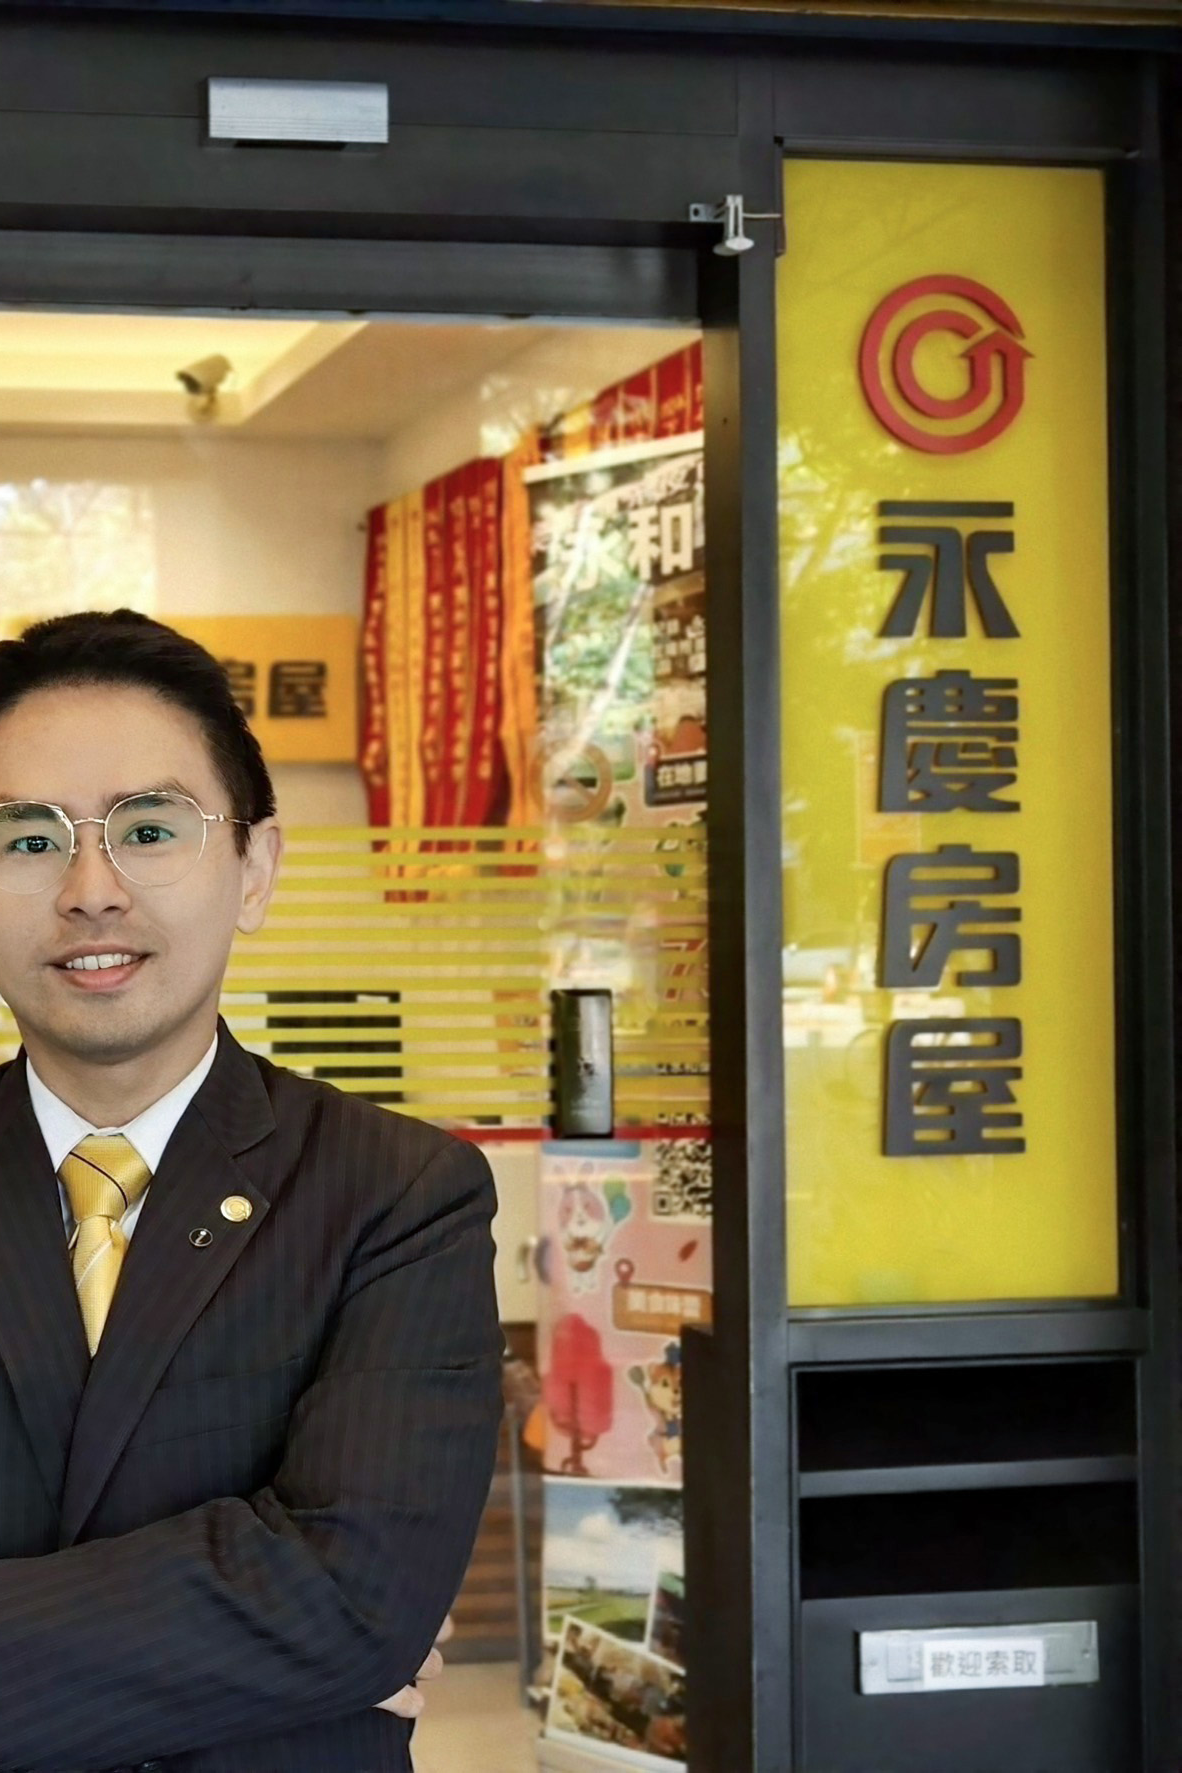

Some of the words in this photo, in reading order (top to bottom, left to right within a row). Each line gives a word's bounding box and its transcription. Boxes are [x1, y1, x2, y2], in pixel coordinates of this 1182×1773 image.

[877, 500, 1026, 1157] 永慶房屋
[930, 1651, 1037, 1678] 歡迎索取
